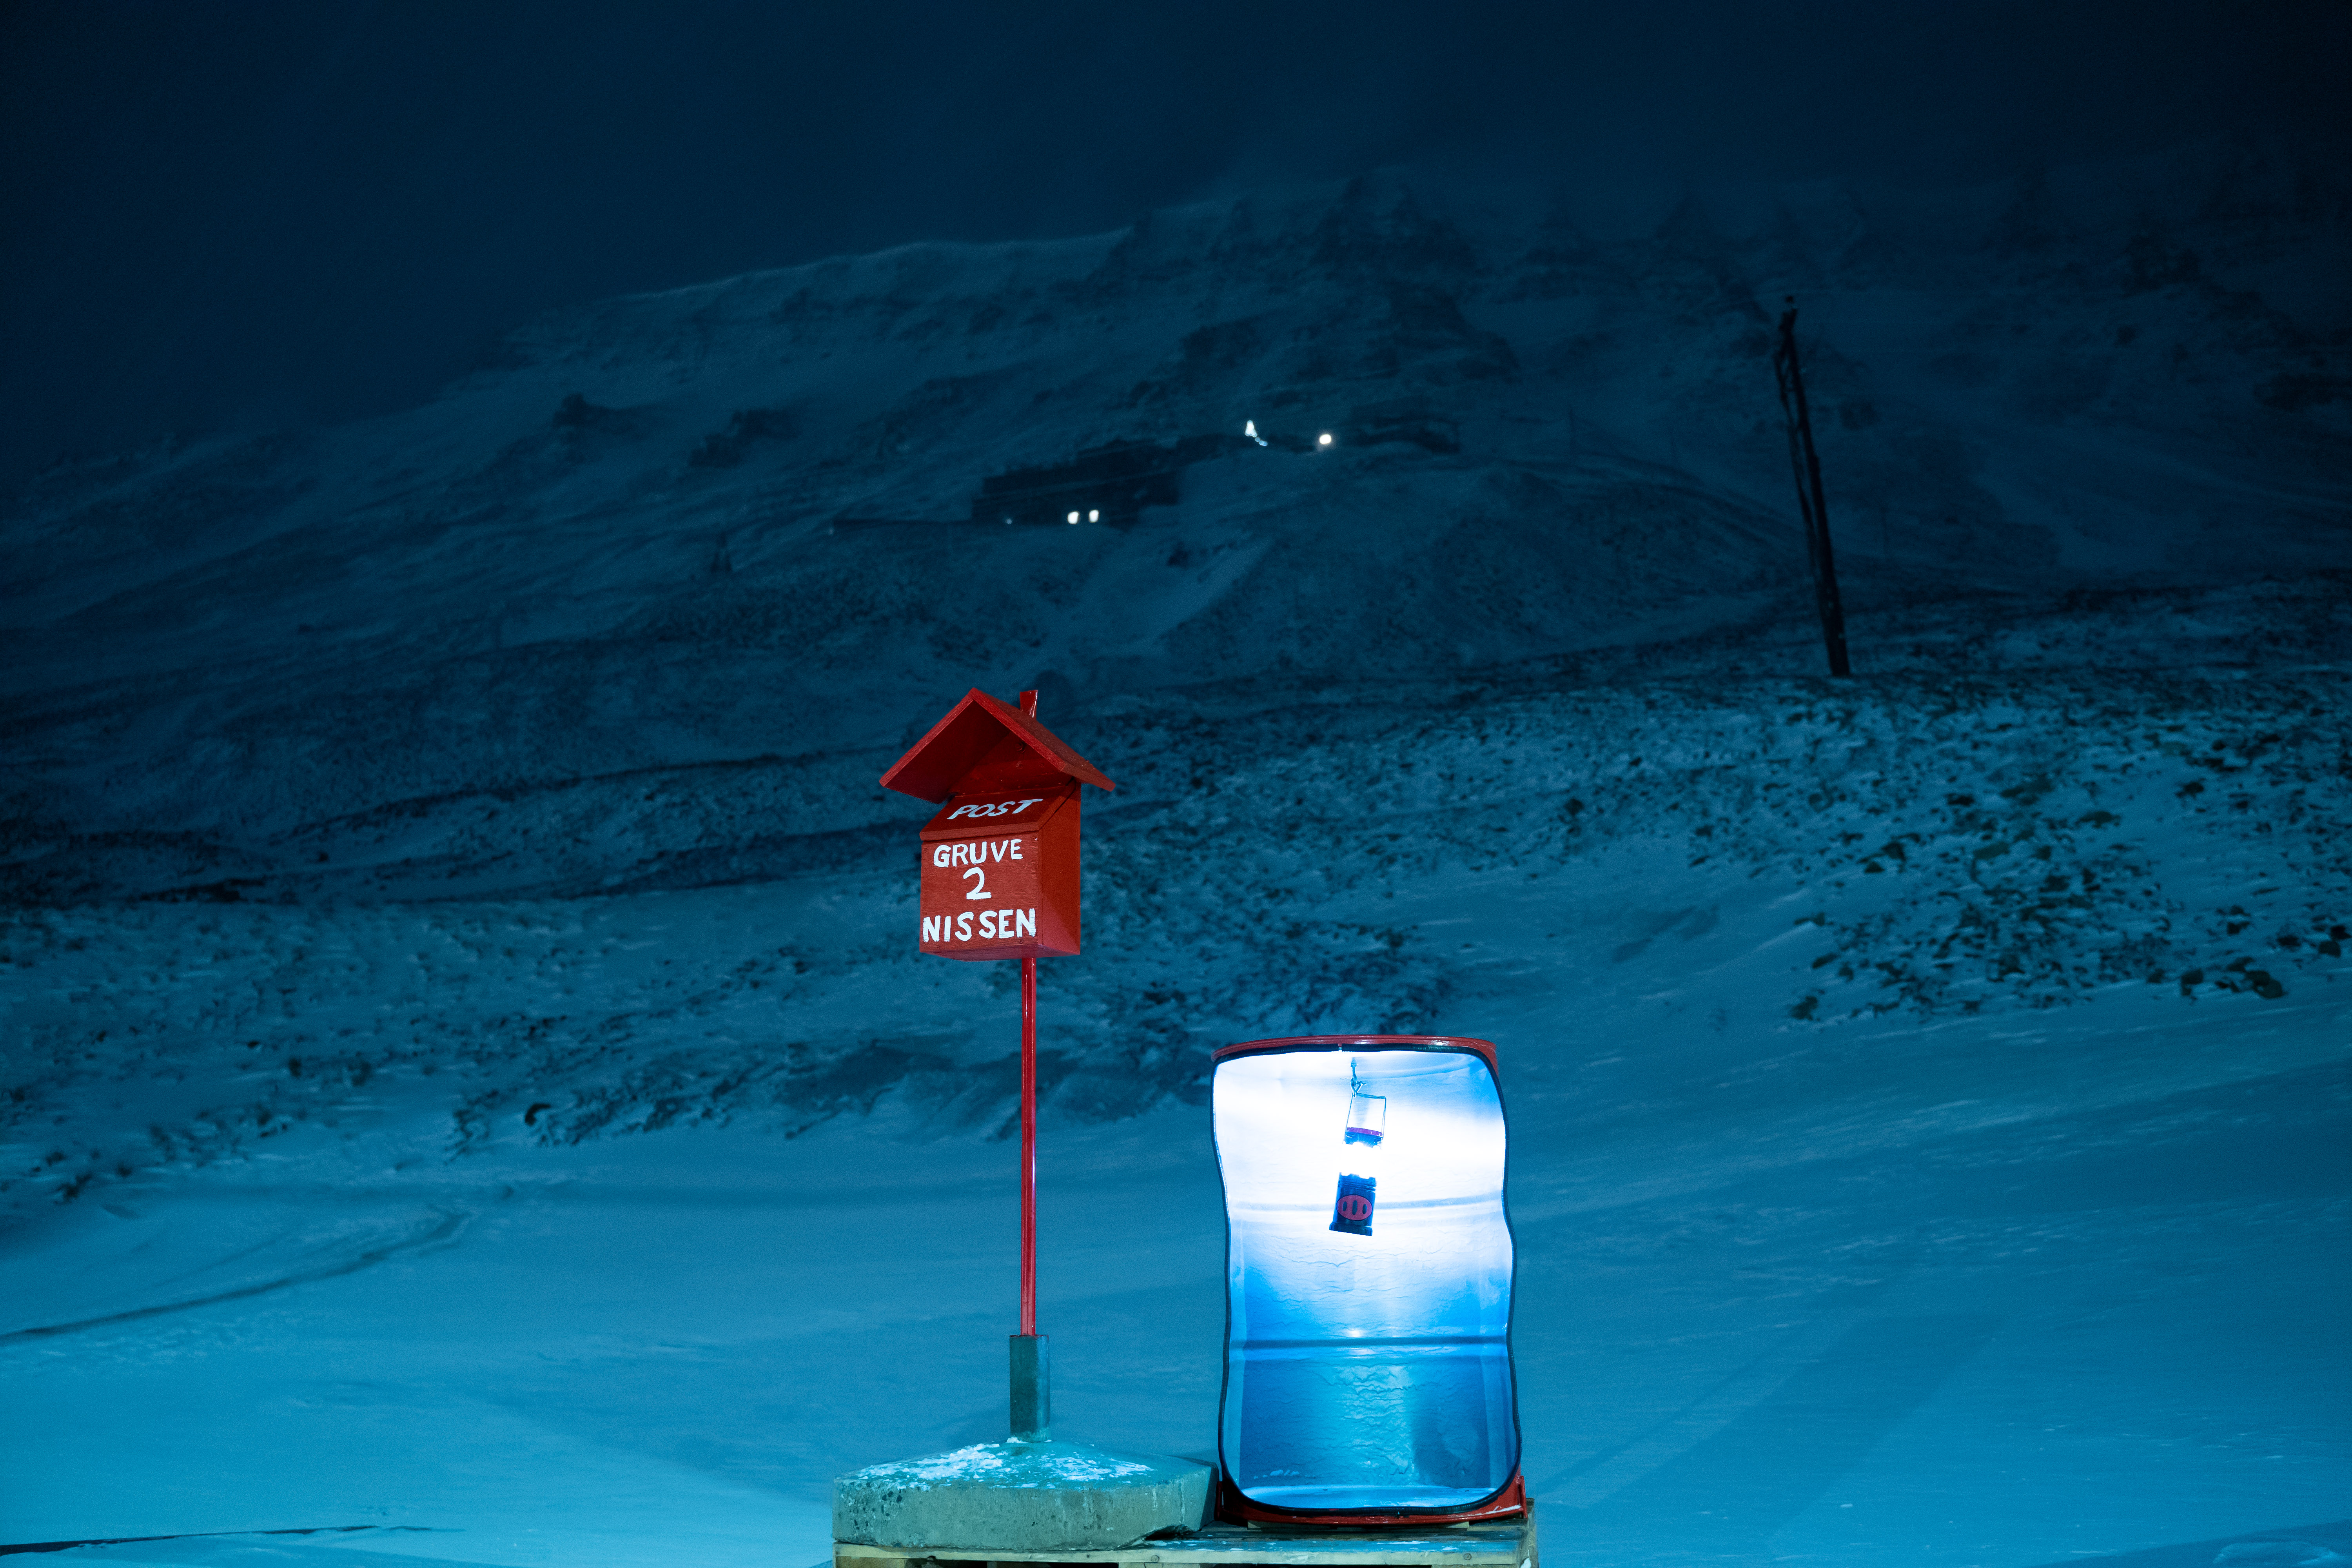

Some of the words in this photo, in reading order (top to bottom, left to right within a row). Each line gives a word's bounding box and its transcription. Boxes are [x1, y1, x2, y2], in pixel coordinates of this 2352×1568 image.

[947, 799, 1043, 820] POST
[933, 839, 1023, 867] GRUVE
[963, 867, 992, 900] 2
[923, 908, 1036, 942] NISSEN
